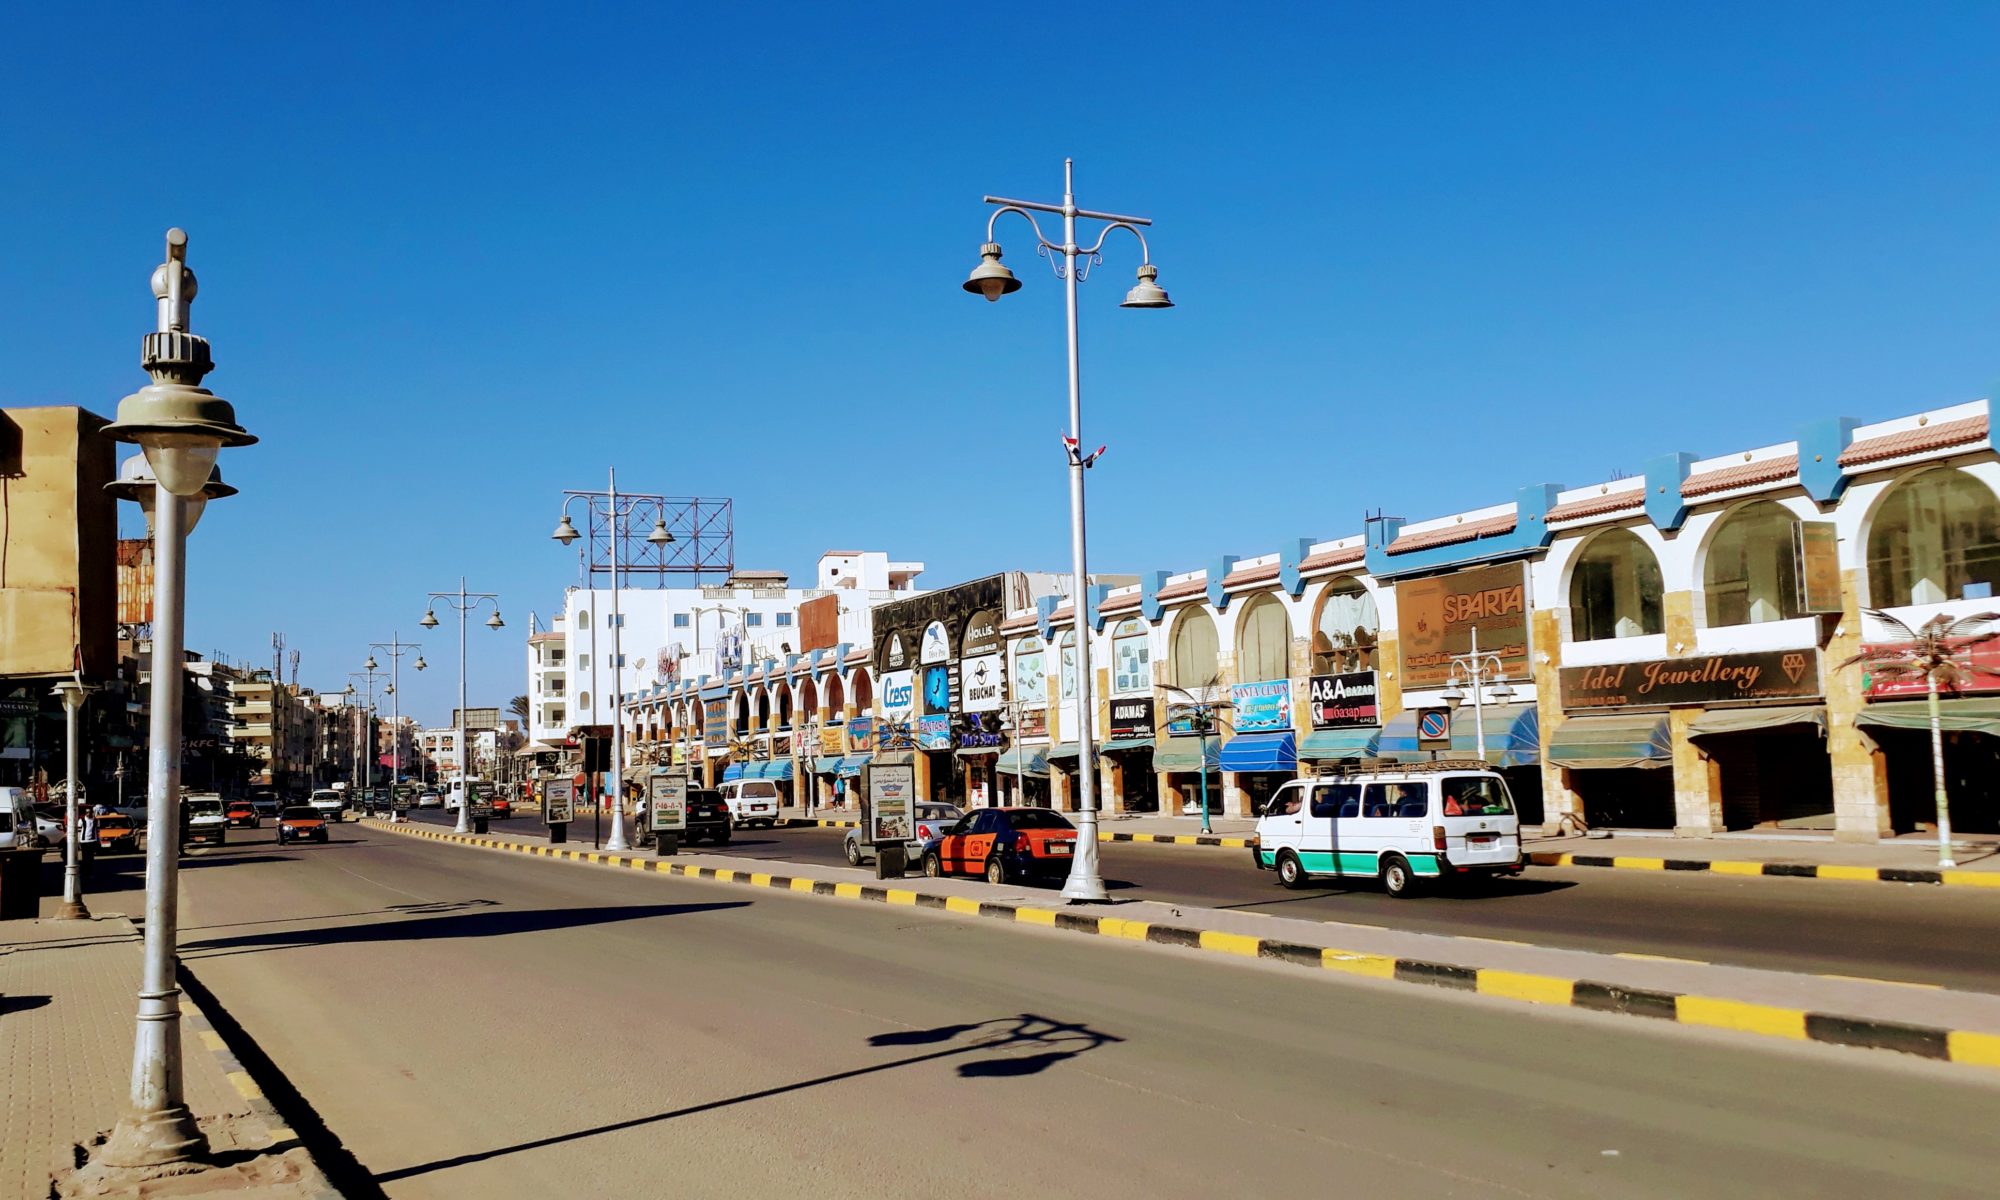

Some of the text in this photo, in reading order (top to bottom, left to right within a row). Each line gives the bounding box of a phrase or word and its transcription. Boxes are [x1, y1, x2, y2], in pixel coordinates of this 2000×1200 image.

[1443, 585, 1523, 623] SPARTA
[1569, 657, 1762, 694] Adel Jewellery
[884, 677, 912, 708] Cressi
[969, 685, 995, 701] BEUCHAT
[1233, 683, 1287, 699] SANTA CLAUS
[1311, 679, 1376, 701] A&A BAZAR
[1114, 703, 1146, 719] ADAMAS
[1334, 705, 1360, 721] базар
[920, 720, 950, 733] FANTASIA
[189, 739, 215, 748] KFC
